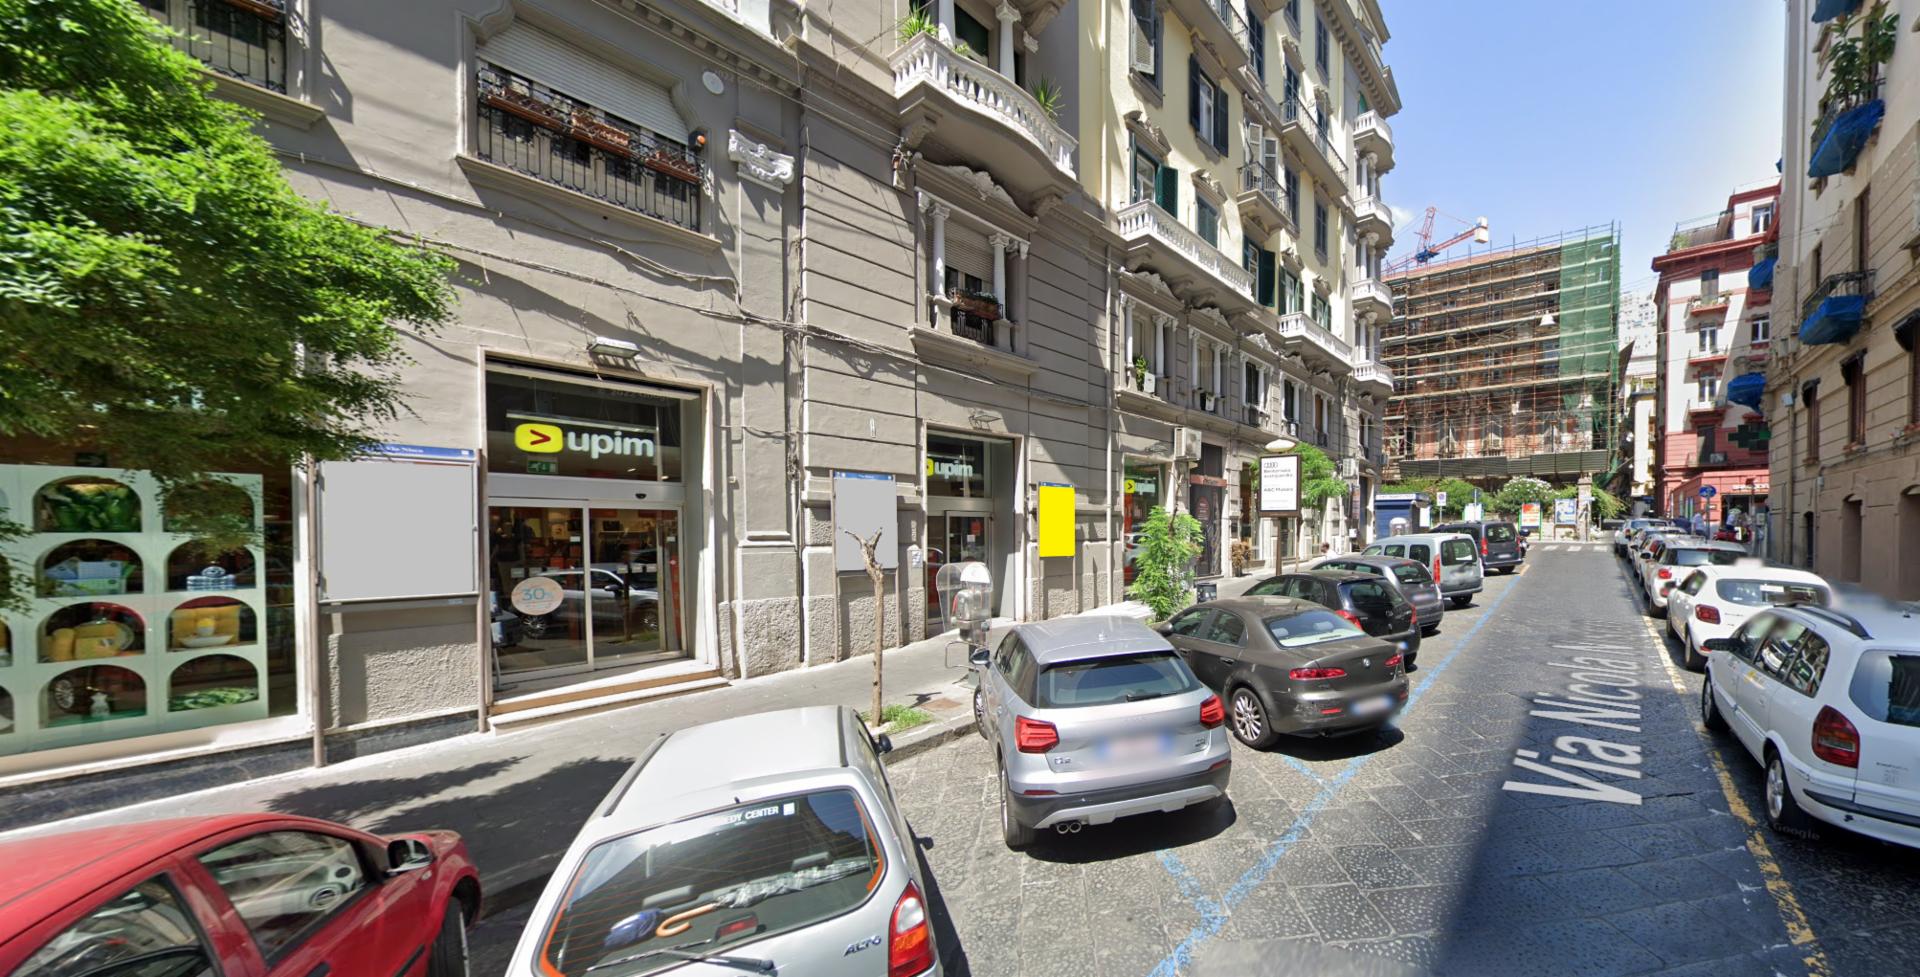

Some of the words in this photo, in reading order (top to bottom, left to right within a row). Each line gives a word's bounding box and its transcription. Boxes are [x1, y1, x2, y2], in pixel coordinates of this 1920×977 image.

[567, 431, 654, 459] upim
[934, 460, 973, 480] upim
[745, 805, 779, 820] CENTER
